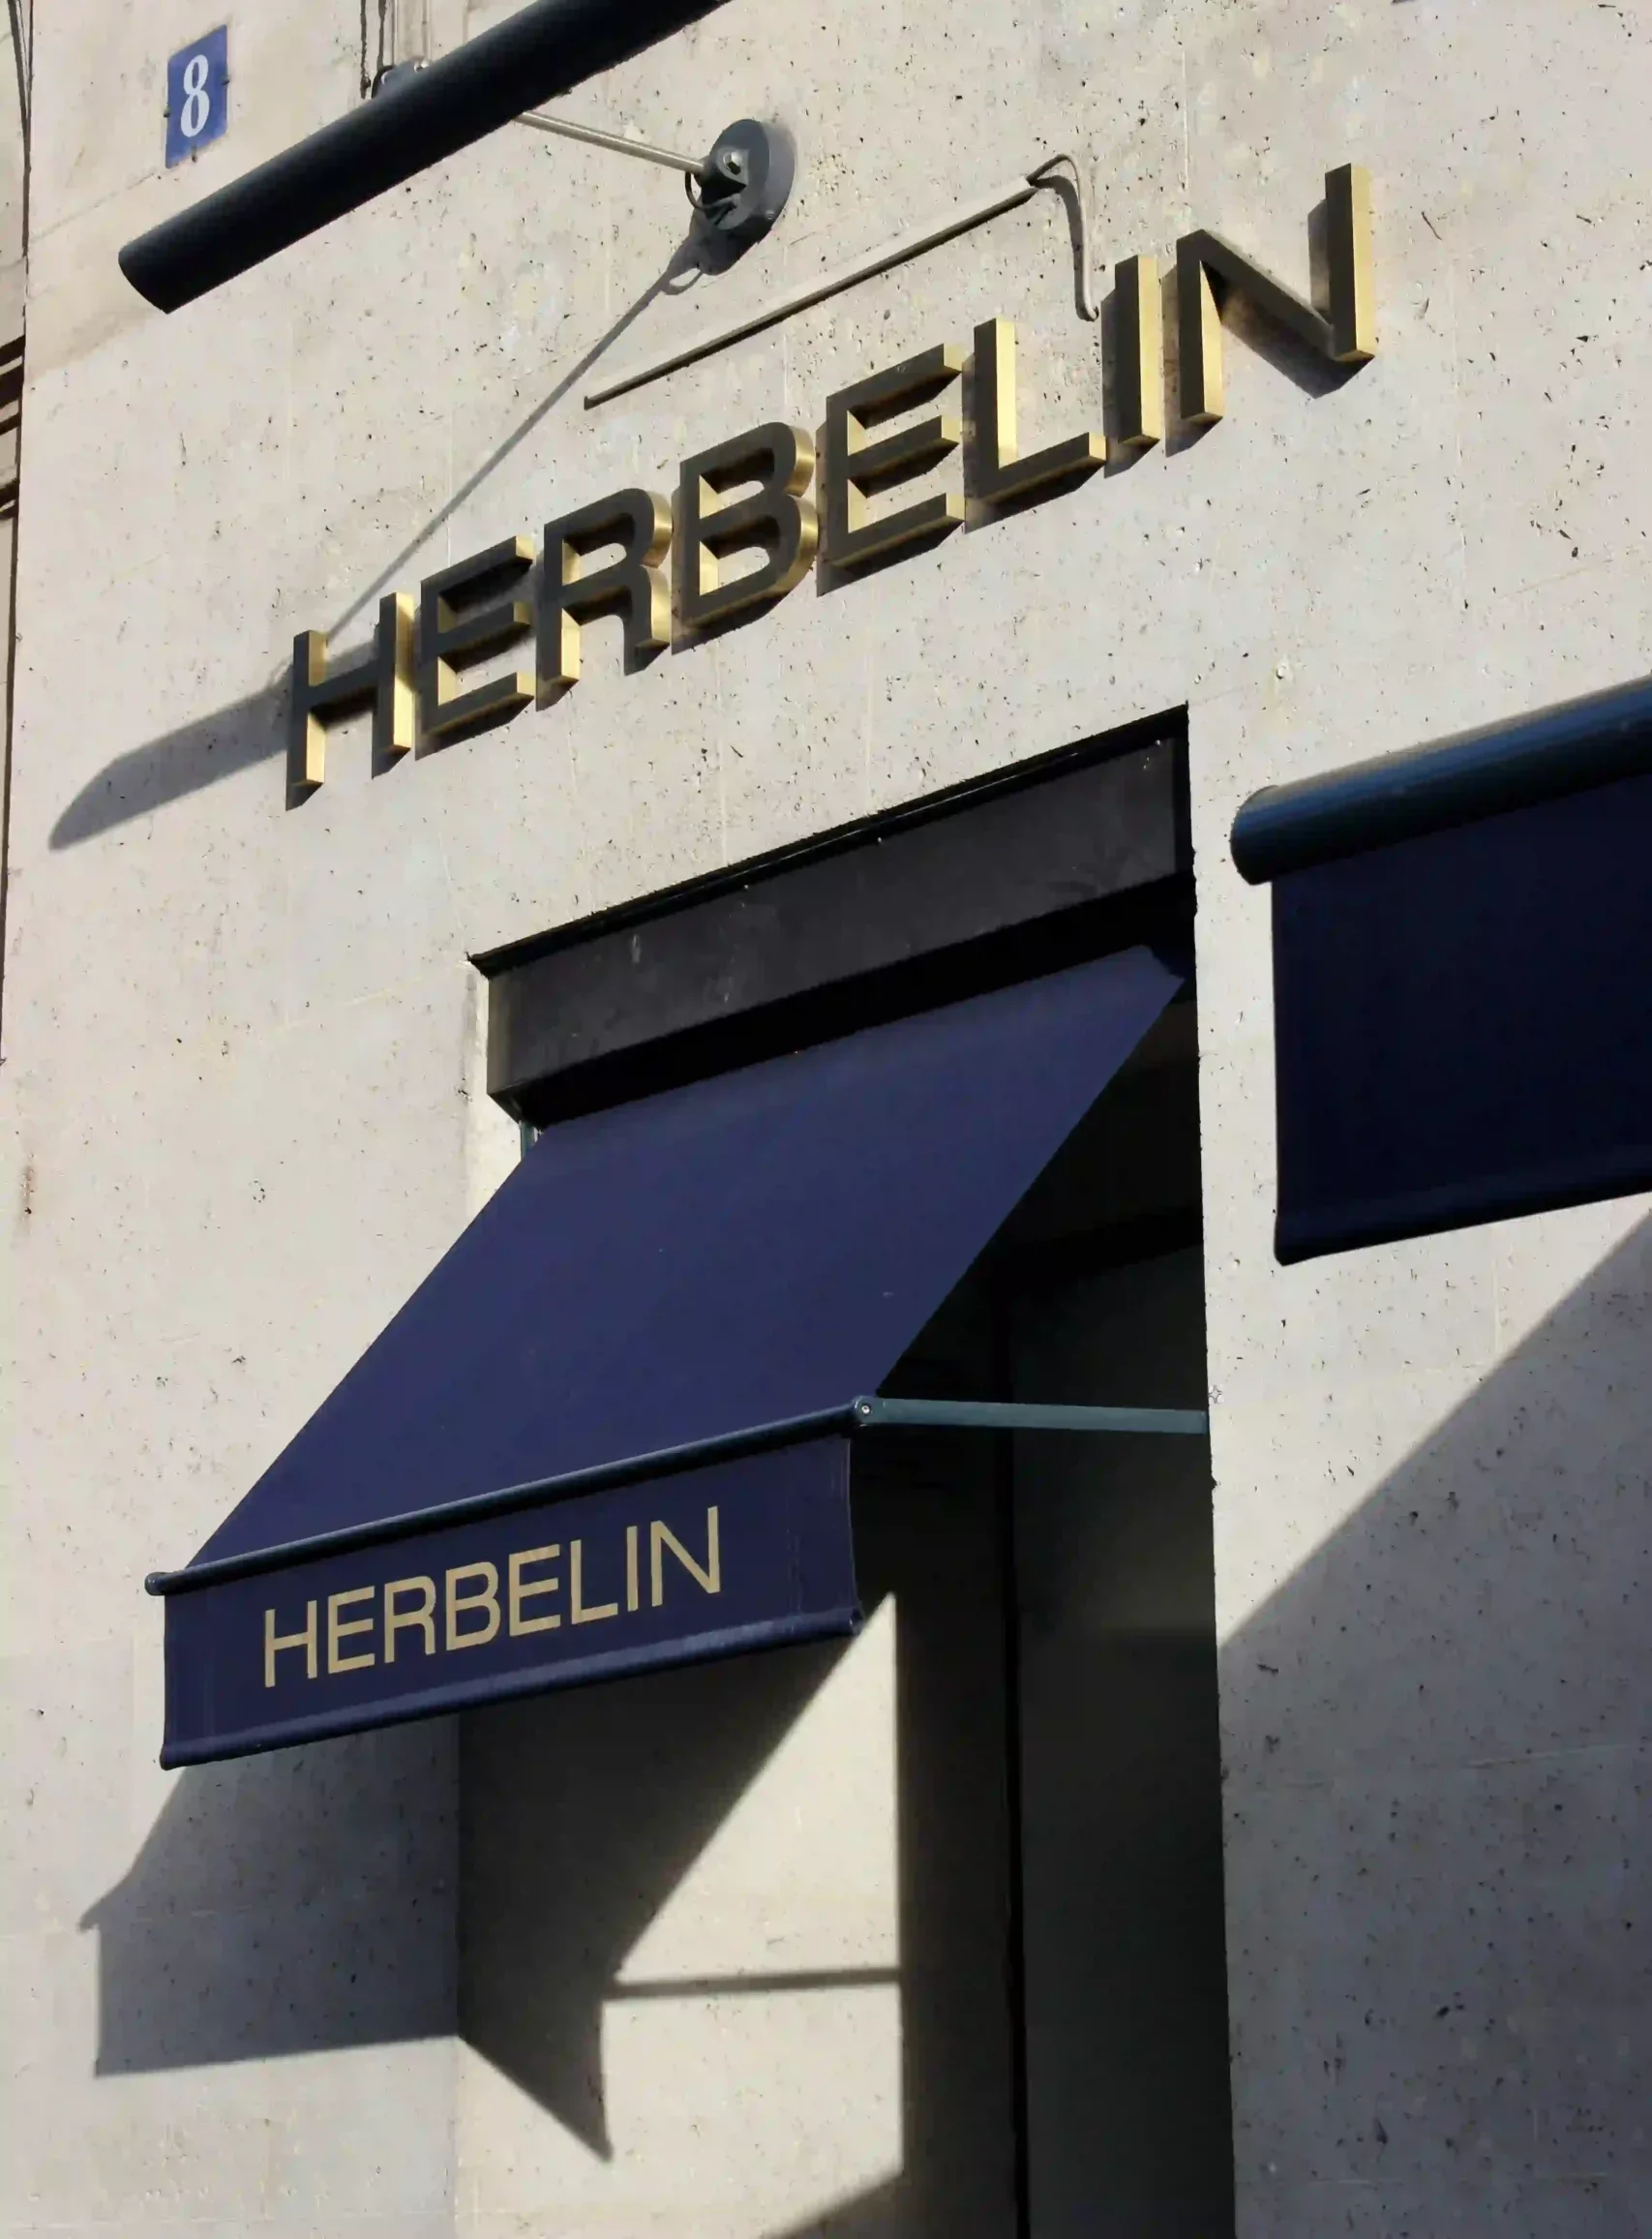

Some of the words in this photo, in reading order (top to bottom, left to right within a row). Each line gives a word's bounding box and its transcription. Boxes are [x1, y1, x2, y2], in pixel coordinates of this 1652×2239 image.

[181, 54, 210, 137] 8
[291, 163, 1375, 787] HERBELIN
[264, 1505, 721, 1687] HERBELIN
